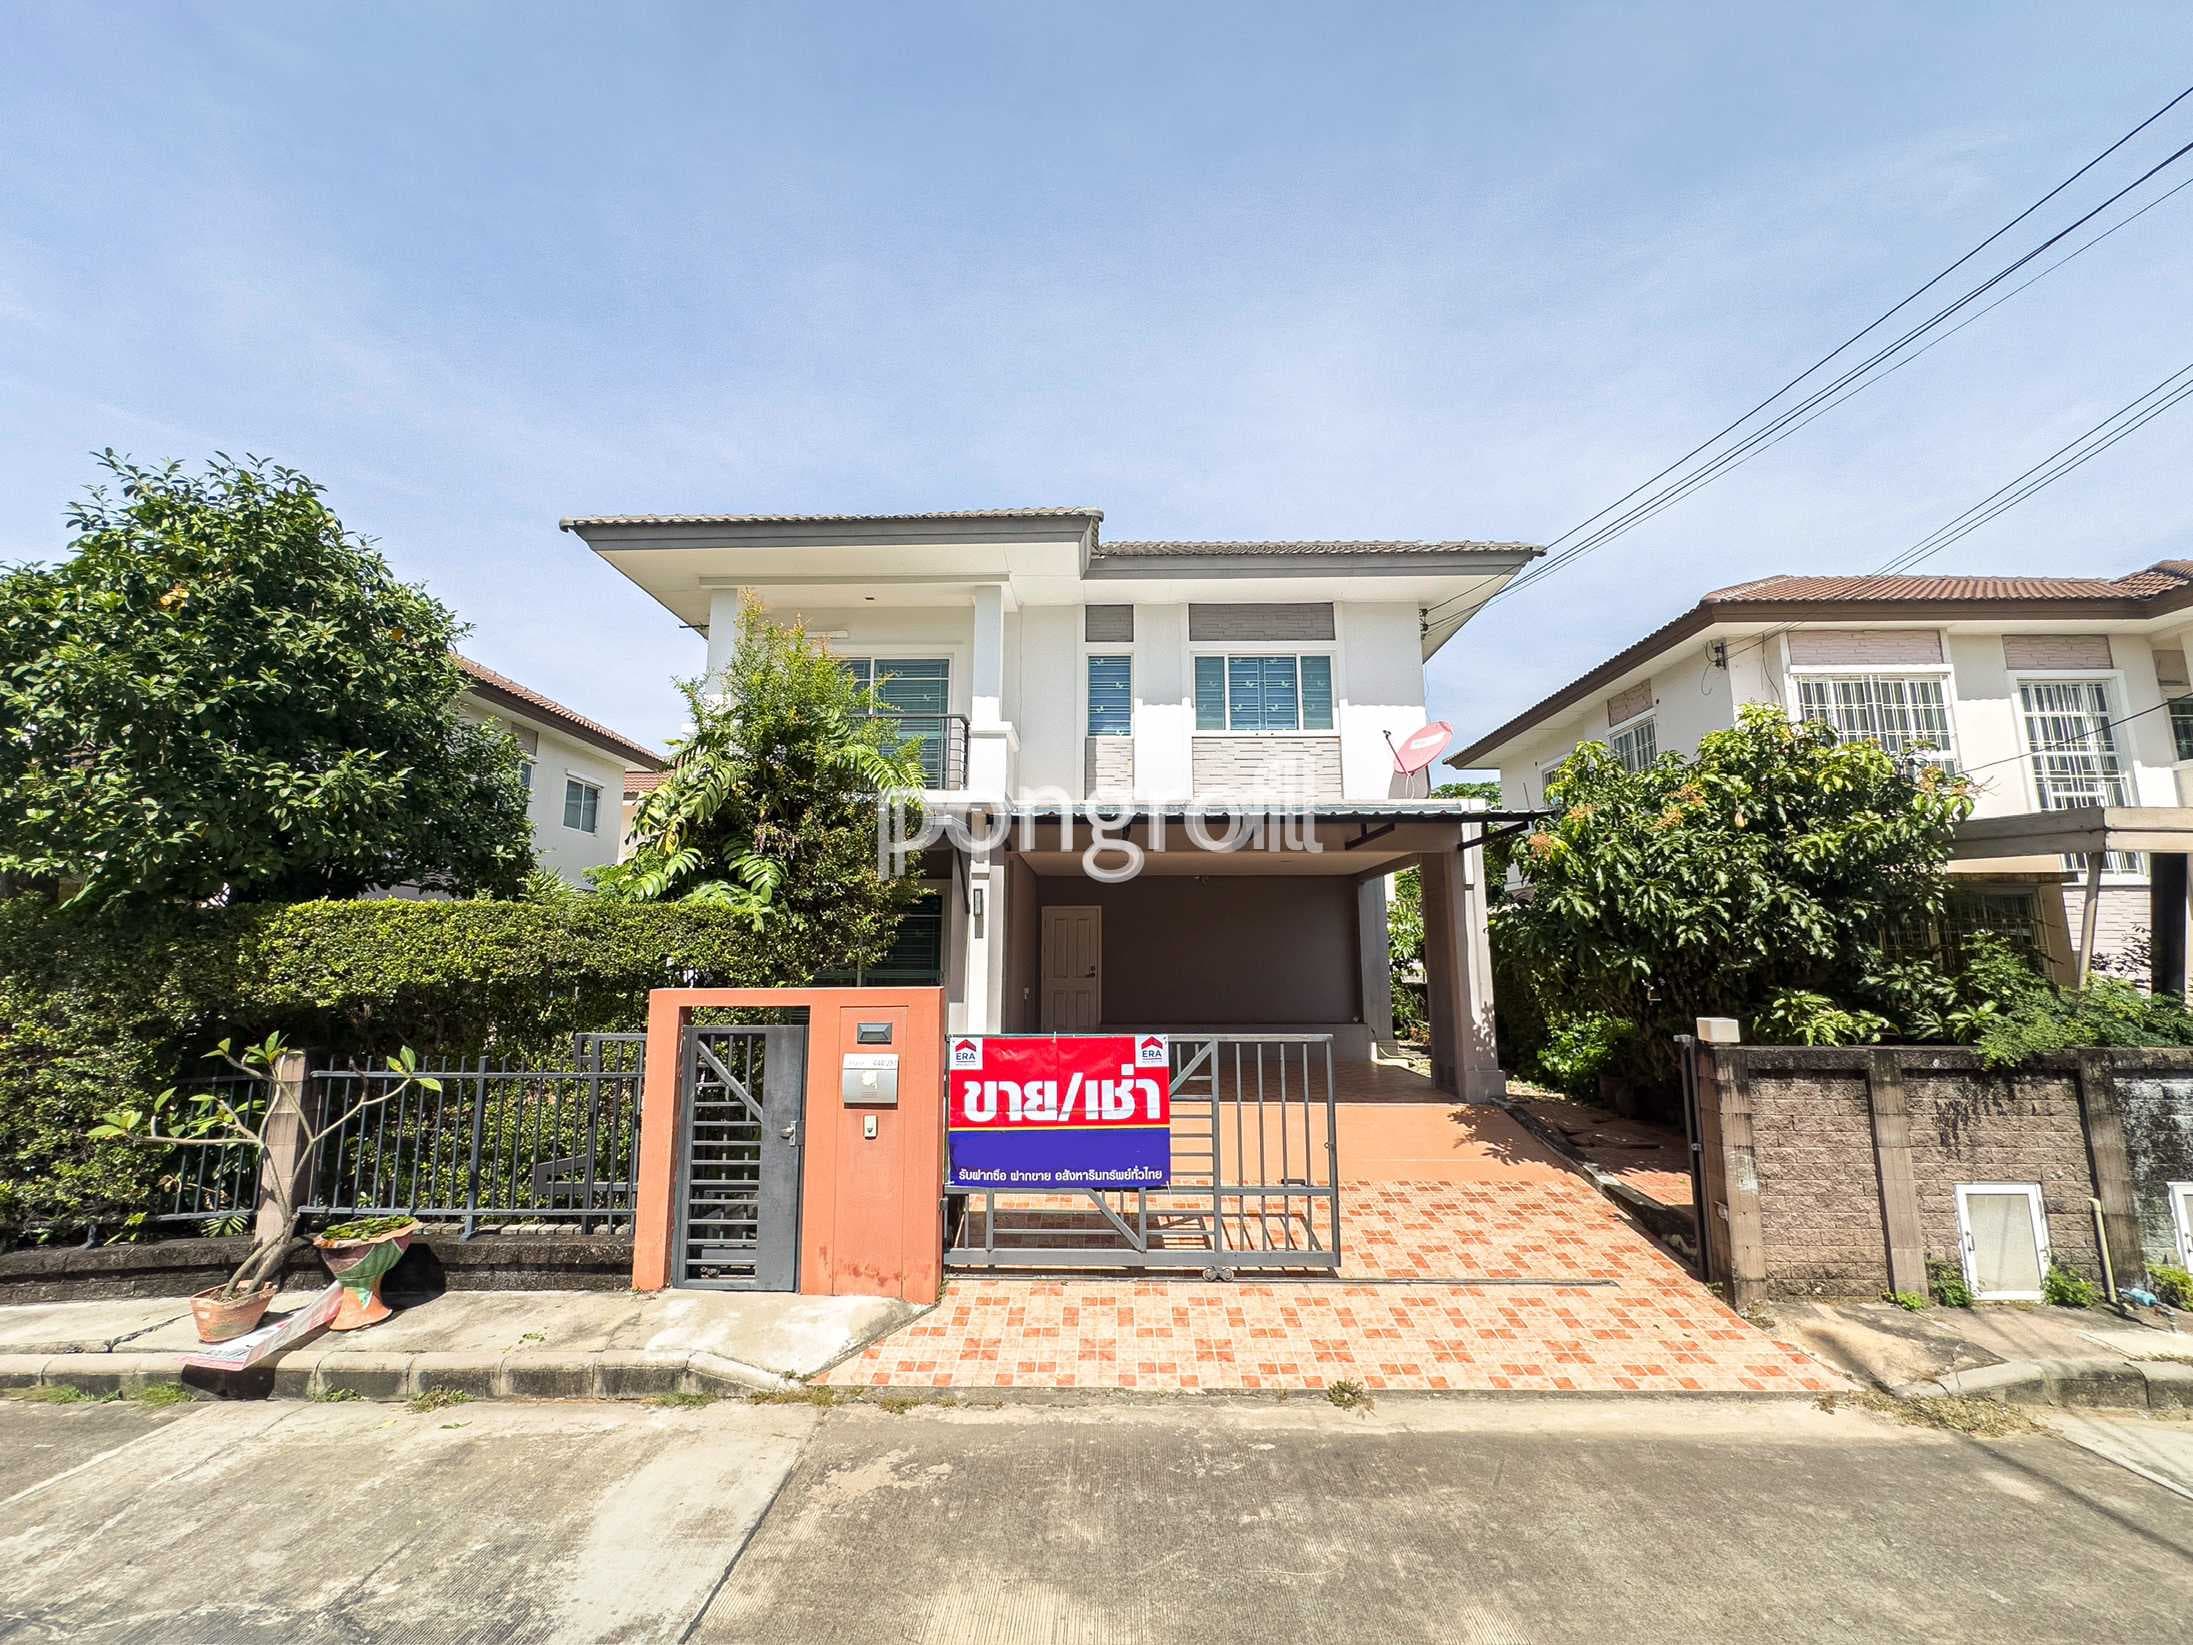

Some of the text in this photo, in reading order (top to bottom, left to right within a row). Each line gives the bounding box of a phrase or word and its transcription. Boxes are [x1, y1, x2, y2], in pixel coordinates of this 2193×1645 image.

[955, 1052, 976, 1061] ERA
[1141, 1049, 1162, 1058] ERA
[963, 1063, 1161, 1122] ขาย/เช่า
[1010, 1170, 1051, 1181] ฝากขาย
